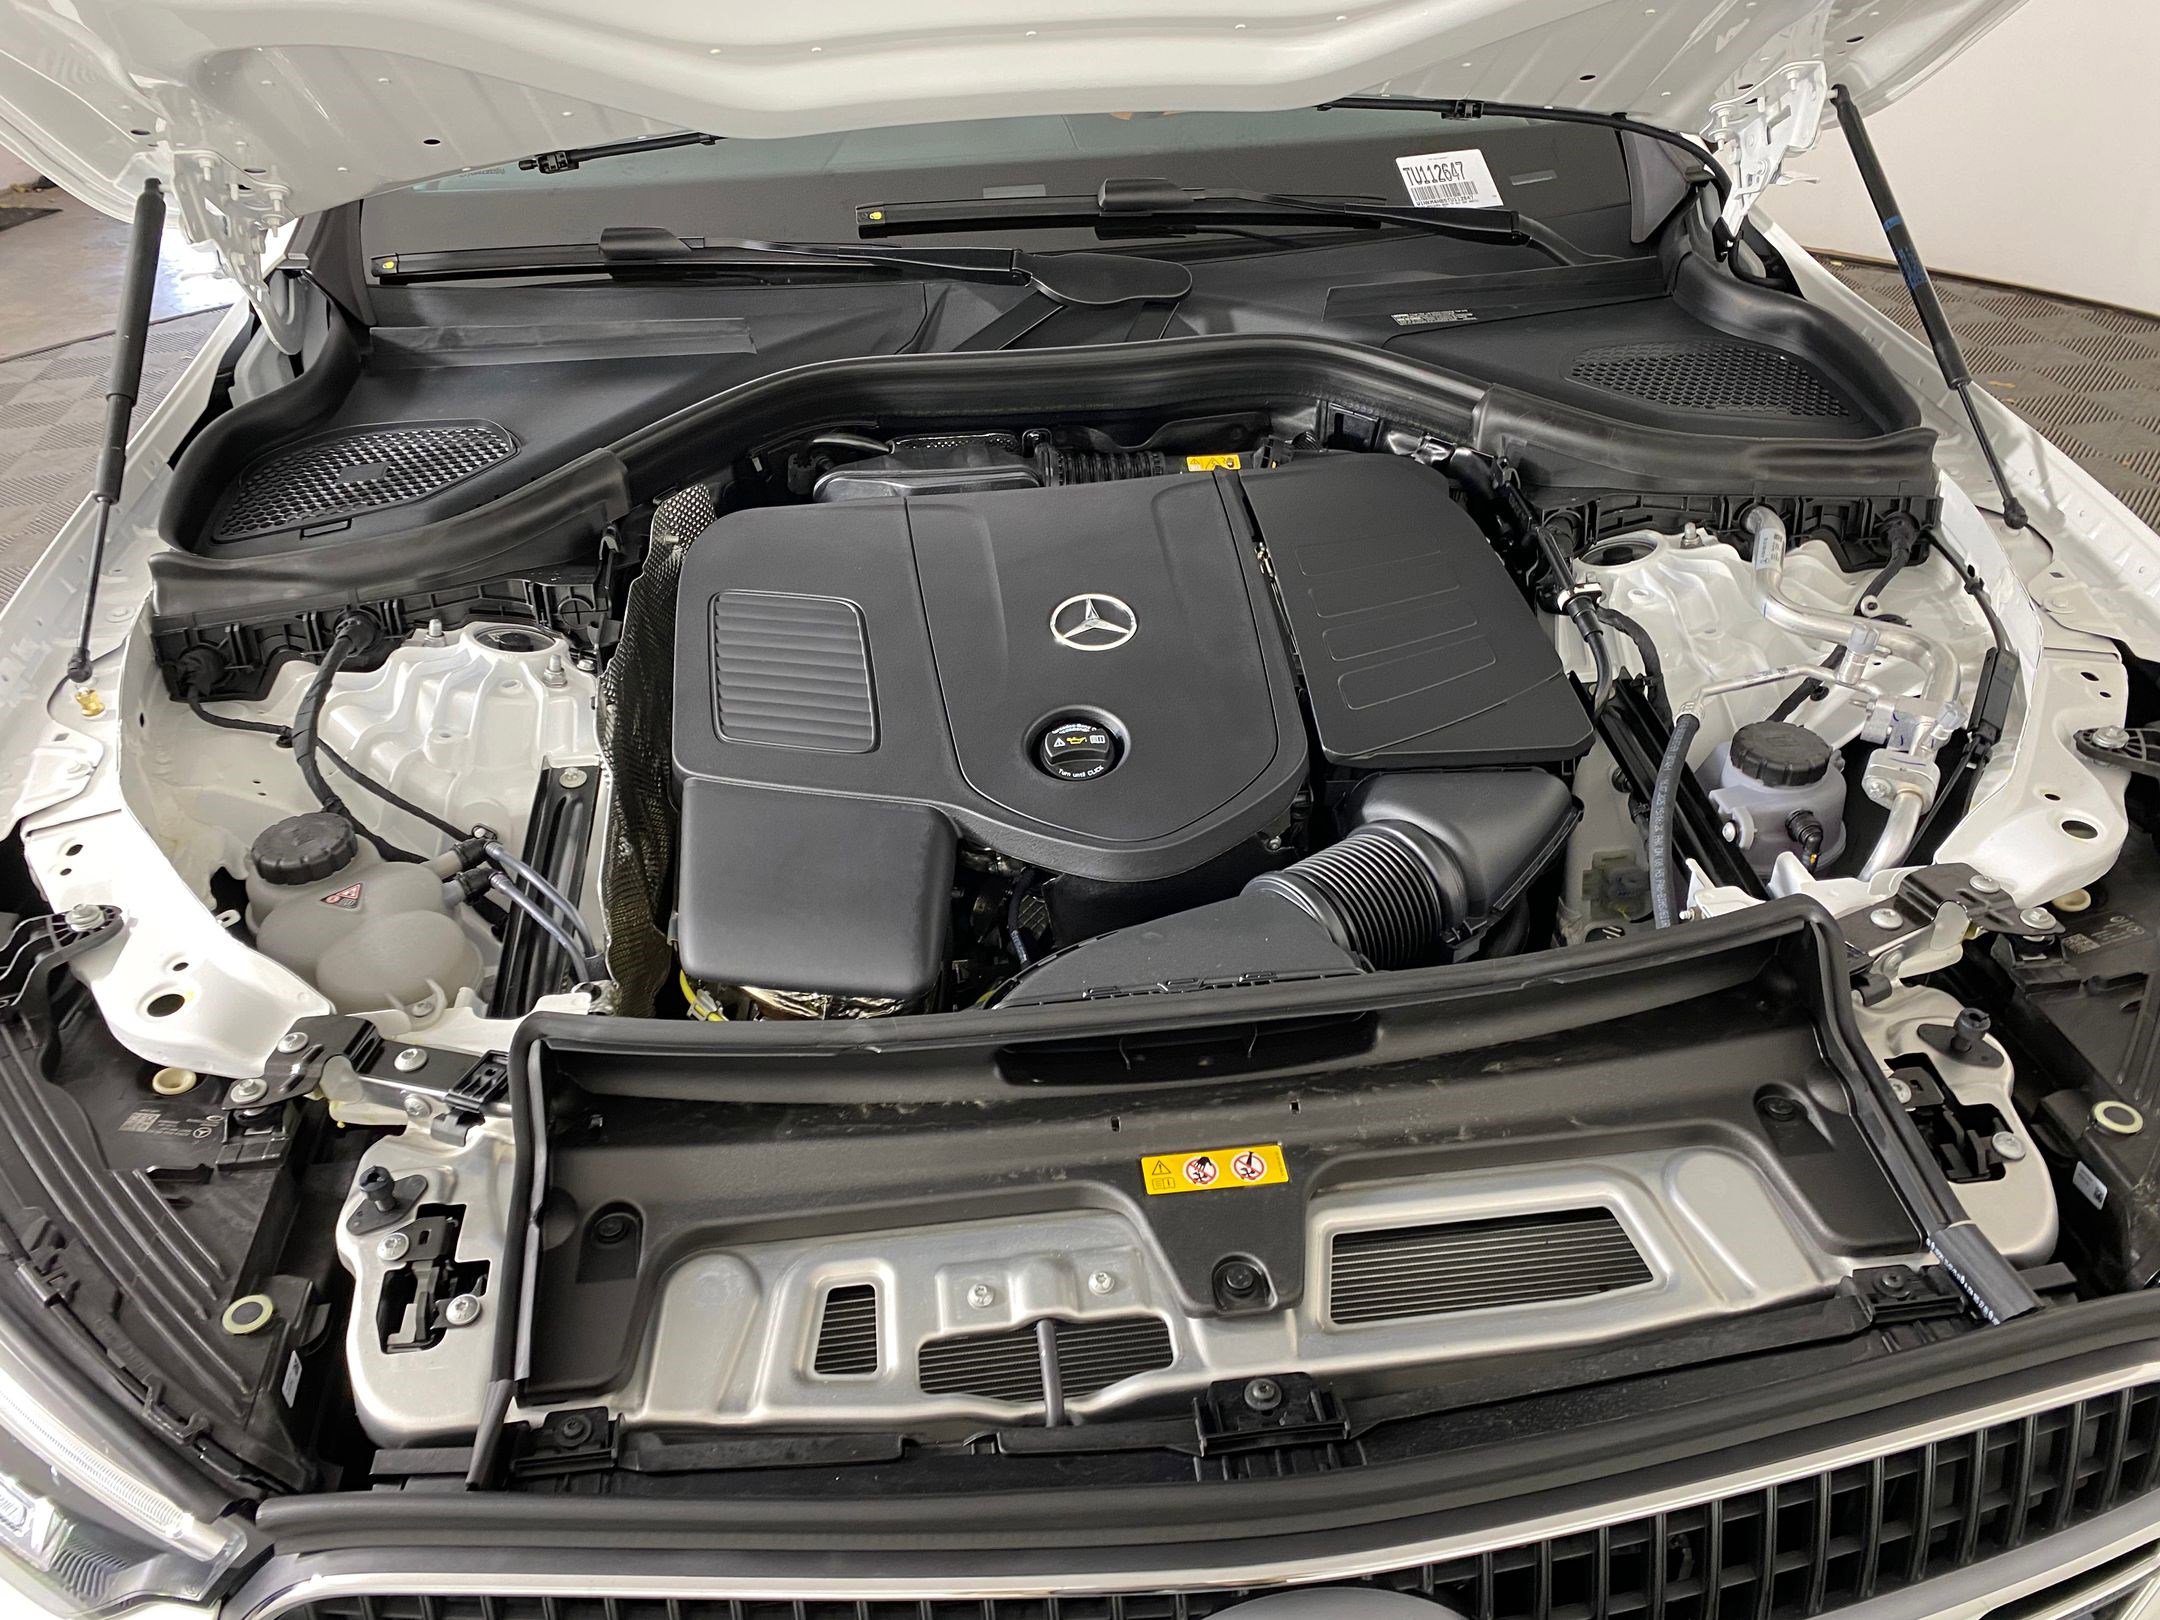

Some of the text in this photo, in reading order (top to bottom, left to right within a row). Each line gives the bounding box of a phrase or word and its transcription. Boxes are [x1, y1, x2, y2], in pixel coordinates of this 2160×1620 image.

[1402, 161, 1466, 186] TU112647
[1058, 768, 1071, 777] Turn
[1087, 765, 1104, 776] CLICK
